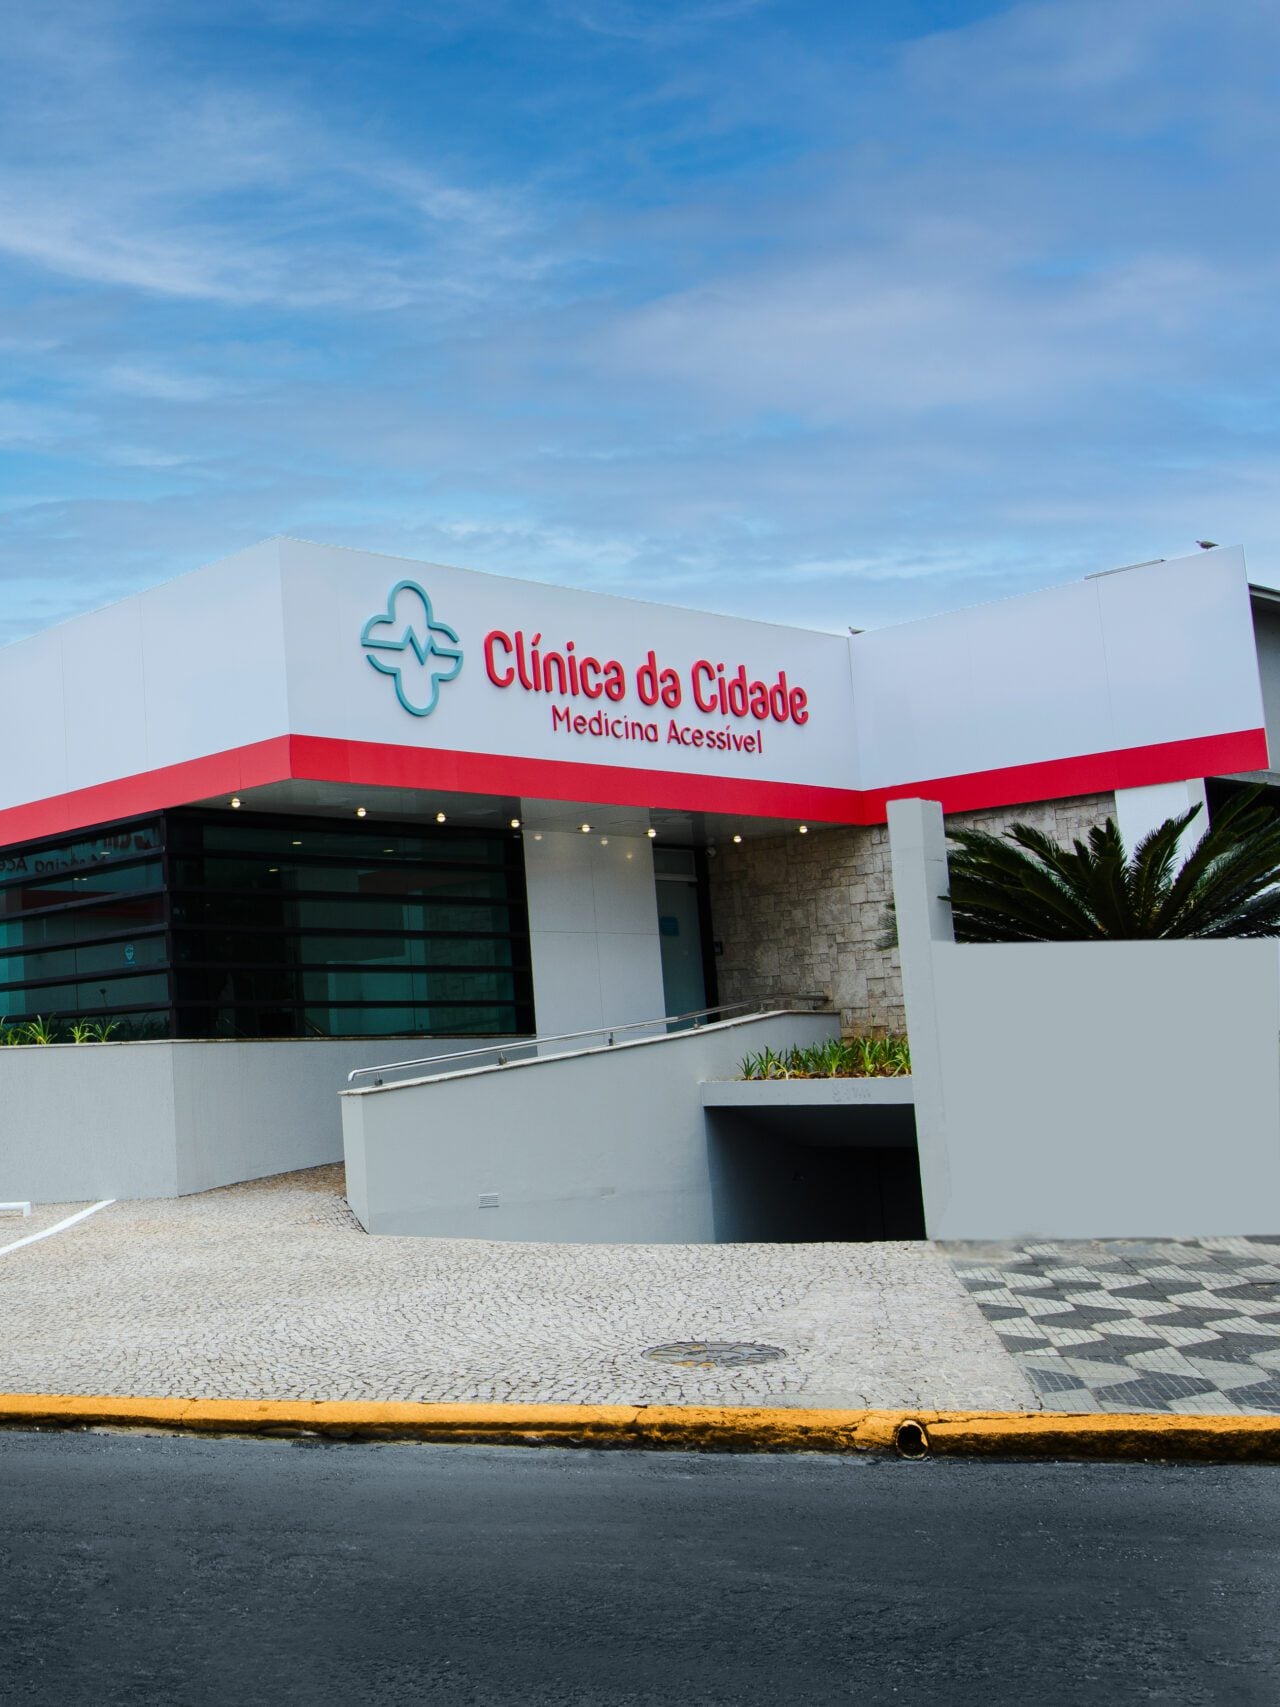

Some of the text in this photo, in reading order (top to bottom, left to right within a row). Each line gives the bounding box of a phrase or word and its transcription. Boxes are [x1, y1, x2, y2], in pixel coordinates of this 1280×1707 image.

[484, 630, 809, 726] Clínica da Cidade
[551, 704, 763, 754] Medicina Acessível
